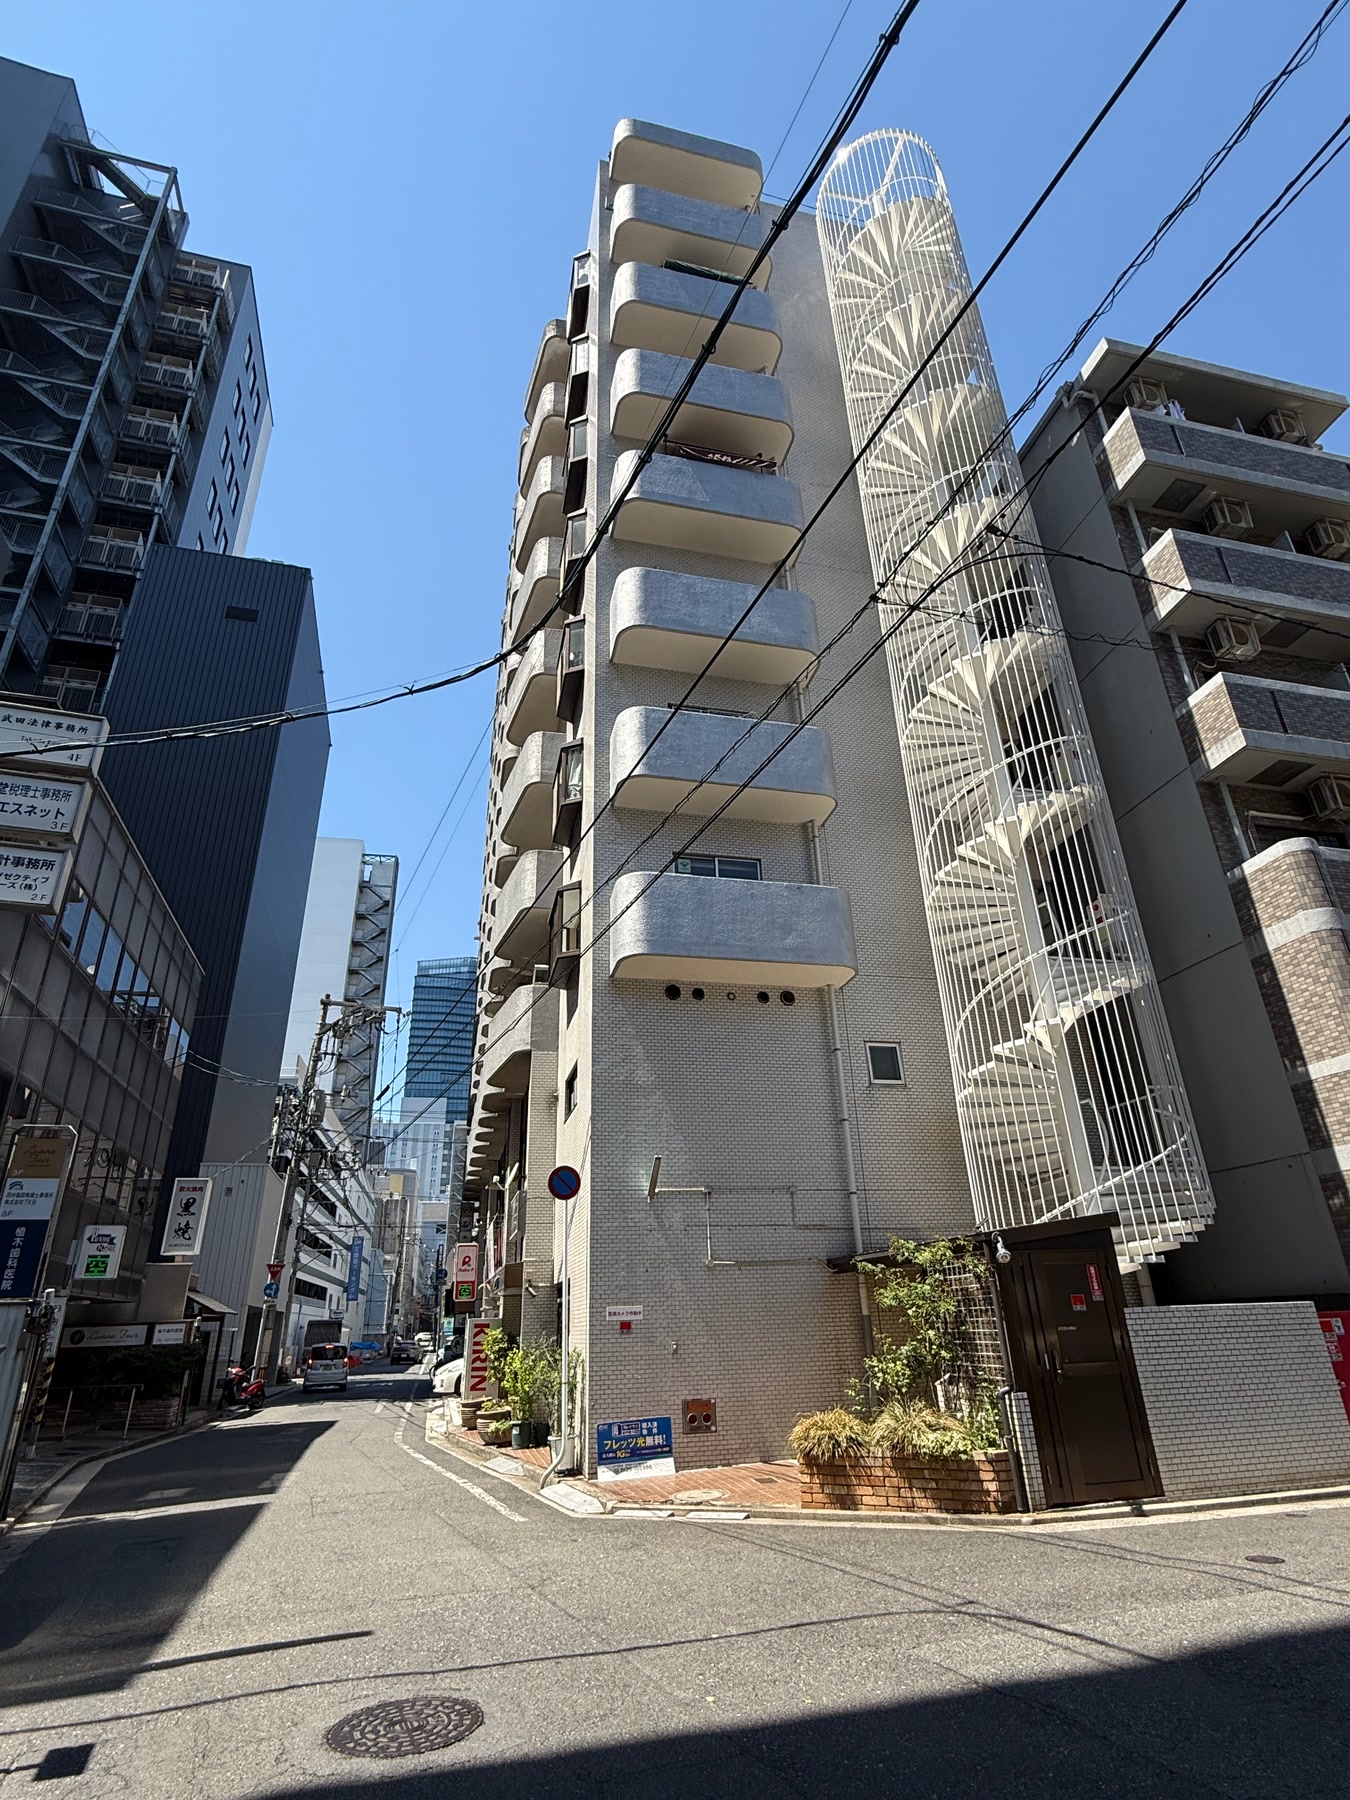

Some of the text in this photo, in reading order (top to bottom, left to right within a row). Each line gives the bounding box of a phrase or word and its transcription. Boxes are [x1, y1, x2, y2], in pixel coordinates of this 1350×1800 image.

[1, 713, 89, 735] 武田法律事務所
[67, 753, 82, 762] 4F
[0, 801, 66, 820] エスネット
[51, 821, 69, 830] 3F
[0, 872, 50, 884] ゼクティブ
[30, 893, 48, 901] 2F
[0, 1226, 27, 1290] 植木歯科医院
[470, 1323, 490, 1391] KIRIN
[603, 1434, 666, 1451] フレッツ光無料!
